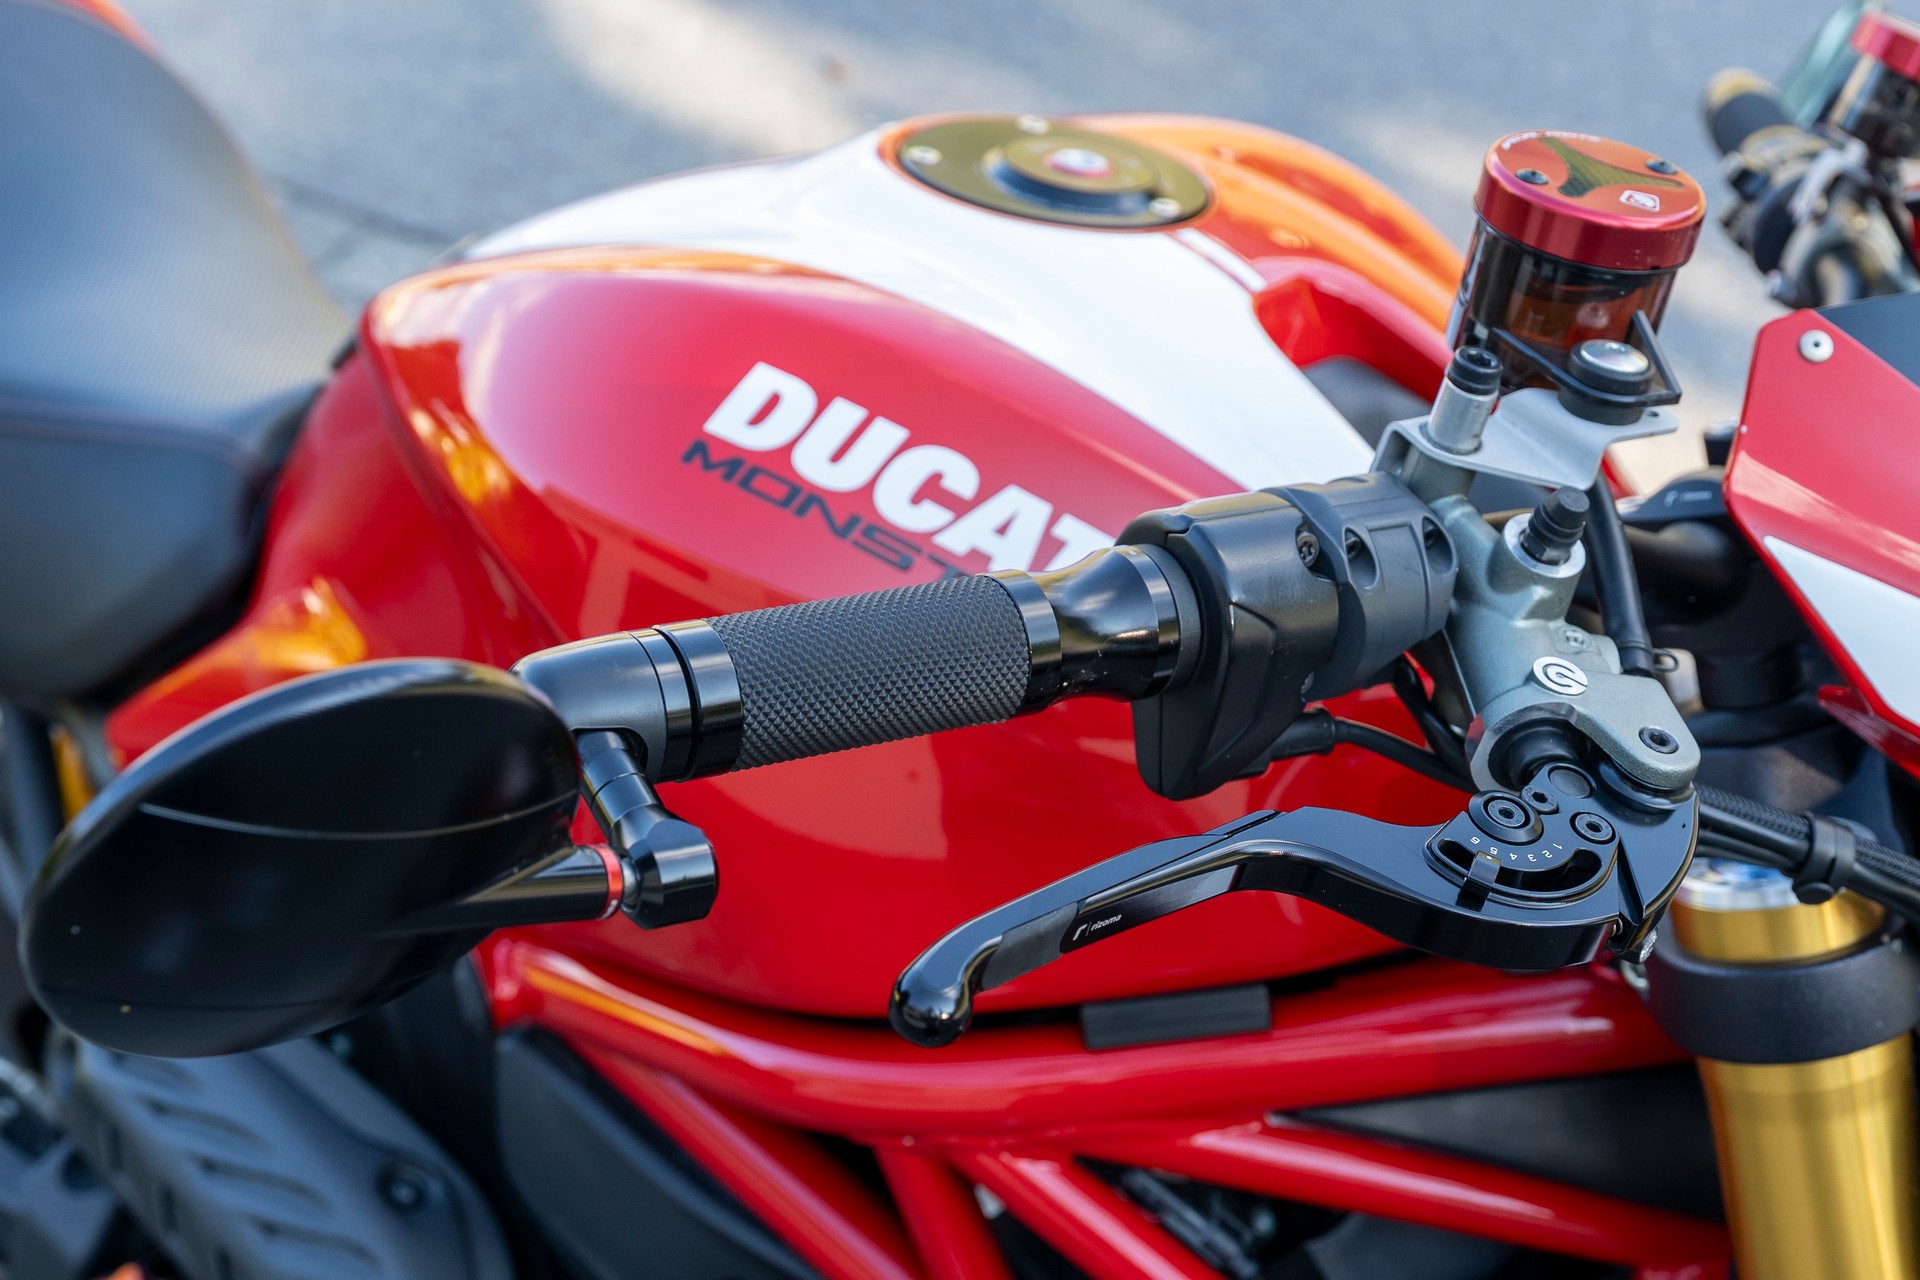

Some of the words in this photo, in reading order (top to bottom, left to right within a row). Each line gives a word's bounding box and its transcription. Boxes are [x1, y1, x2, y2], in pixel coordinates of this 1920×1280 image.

[702, 361, 1118, 572] DUCAT
[1489, 846, 1499, 856] 5
[1542, 850, 1553, 859] 2
[1509, 852, 1518, 861] 4
[1527, 854, 1537, 862] 3
[1091, 914, 1122, 931] rizoma
